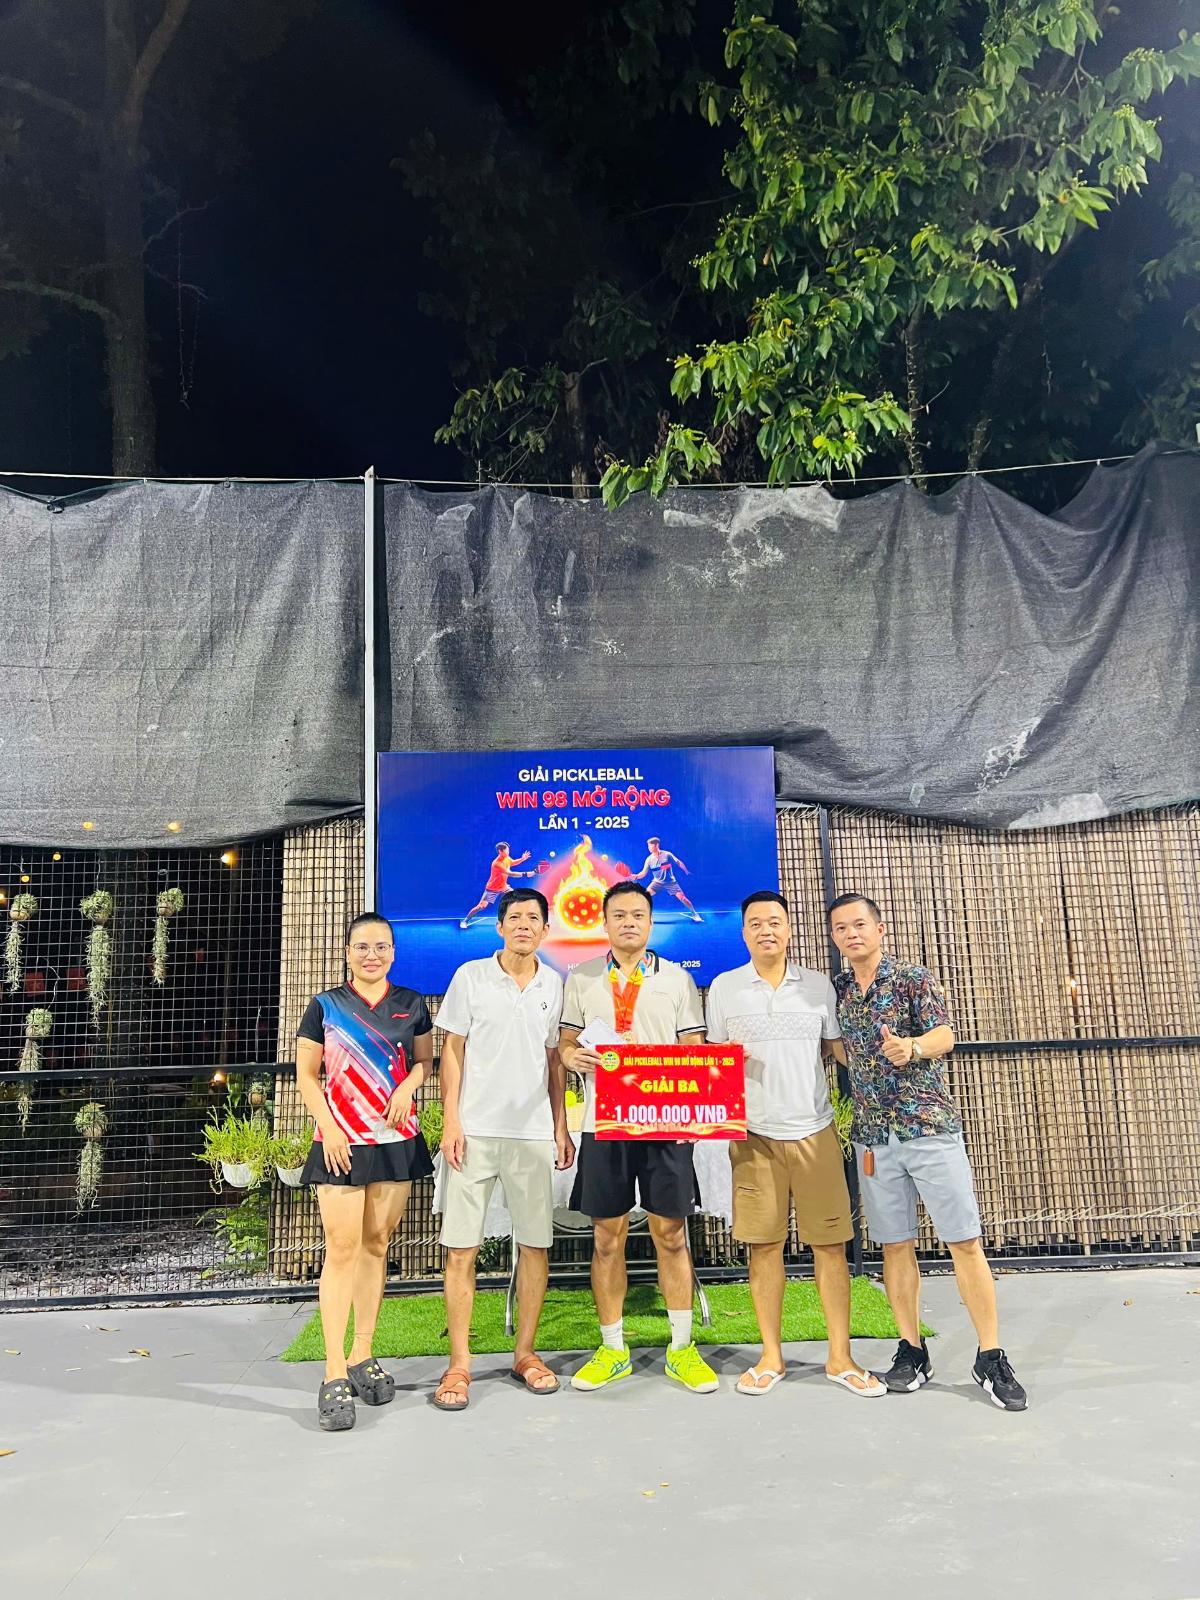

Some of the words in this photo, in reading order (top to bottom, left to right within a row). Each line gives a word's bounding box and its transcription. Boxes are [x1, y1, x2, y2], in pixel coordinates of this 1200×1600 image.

[518, 766, 549, 782] GIẢI
[553, 768, 643, 781] PICKLEBALL
[496, 791, 538, 808] WIN
[542, 791, 567, 807] 98
[573, 785, 606, 807] MỞ
[612, 786, 671, 811] RỘNG
[539, 813, 568, 829] LẦN
[571, 817, 579, 829] 1
[595, 816, 630, 828] 2025
[682, 960, 701, 968] 2025
[640, 1075, 674, 1093] GIẢI
[678, 1080, 700, 1093] BA
[614, 1104, 691, 1123] 1.000.000
[694, 1104, 727, 1123] VNĐ
